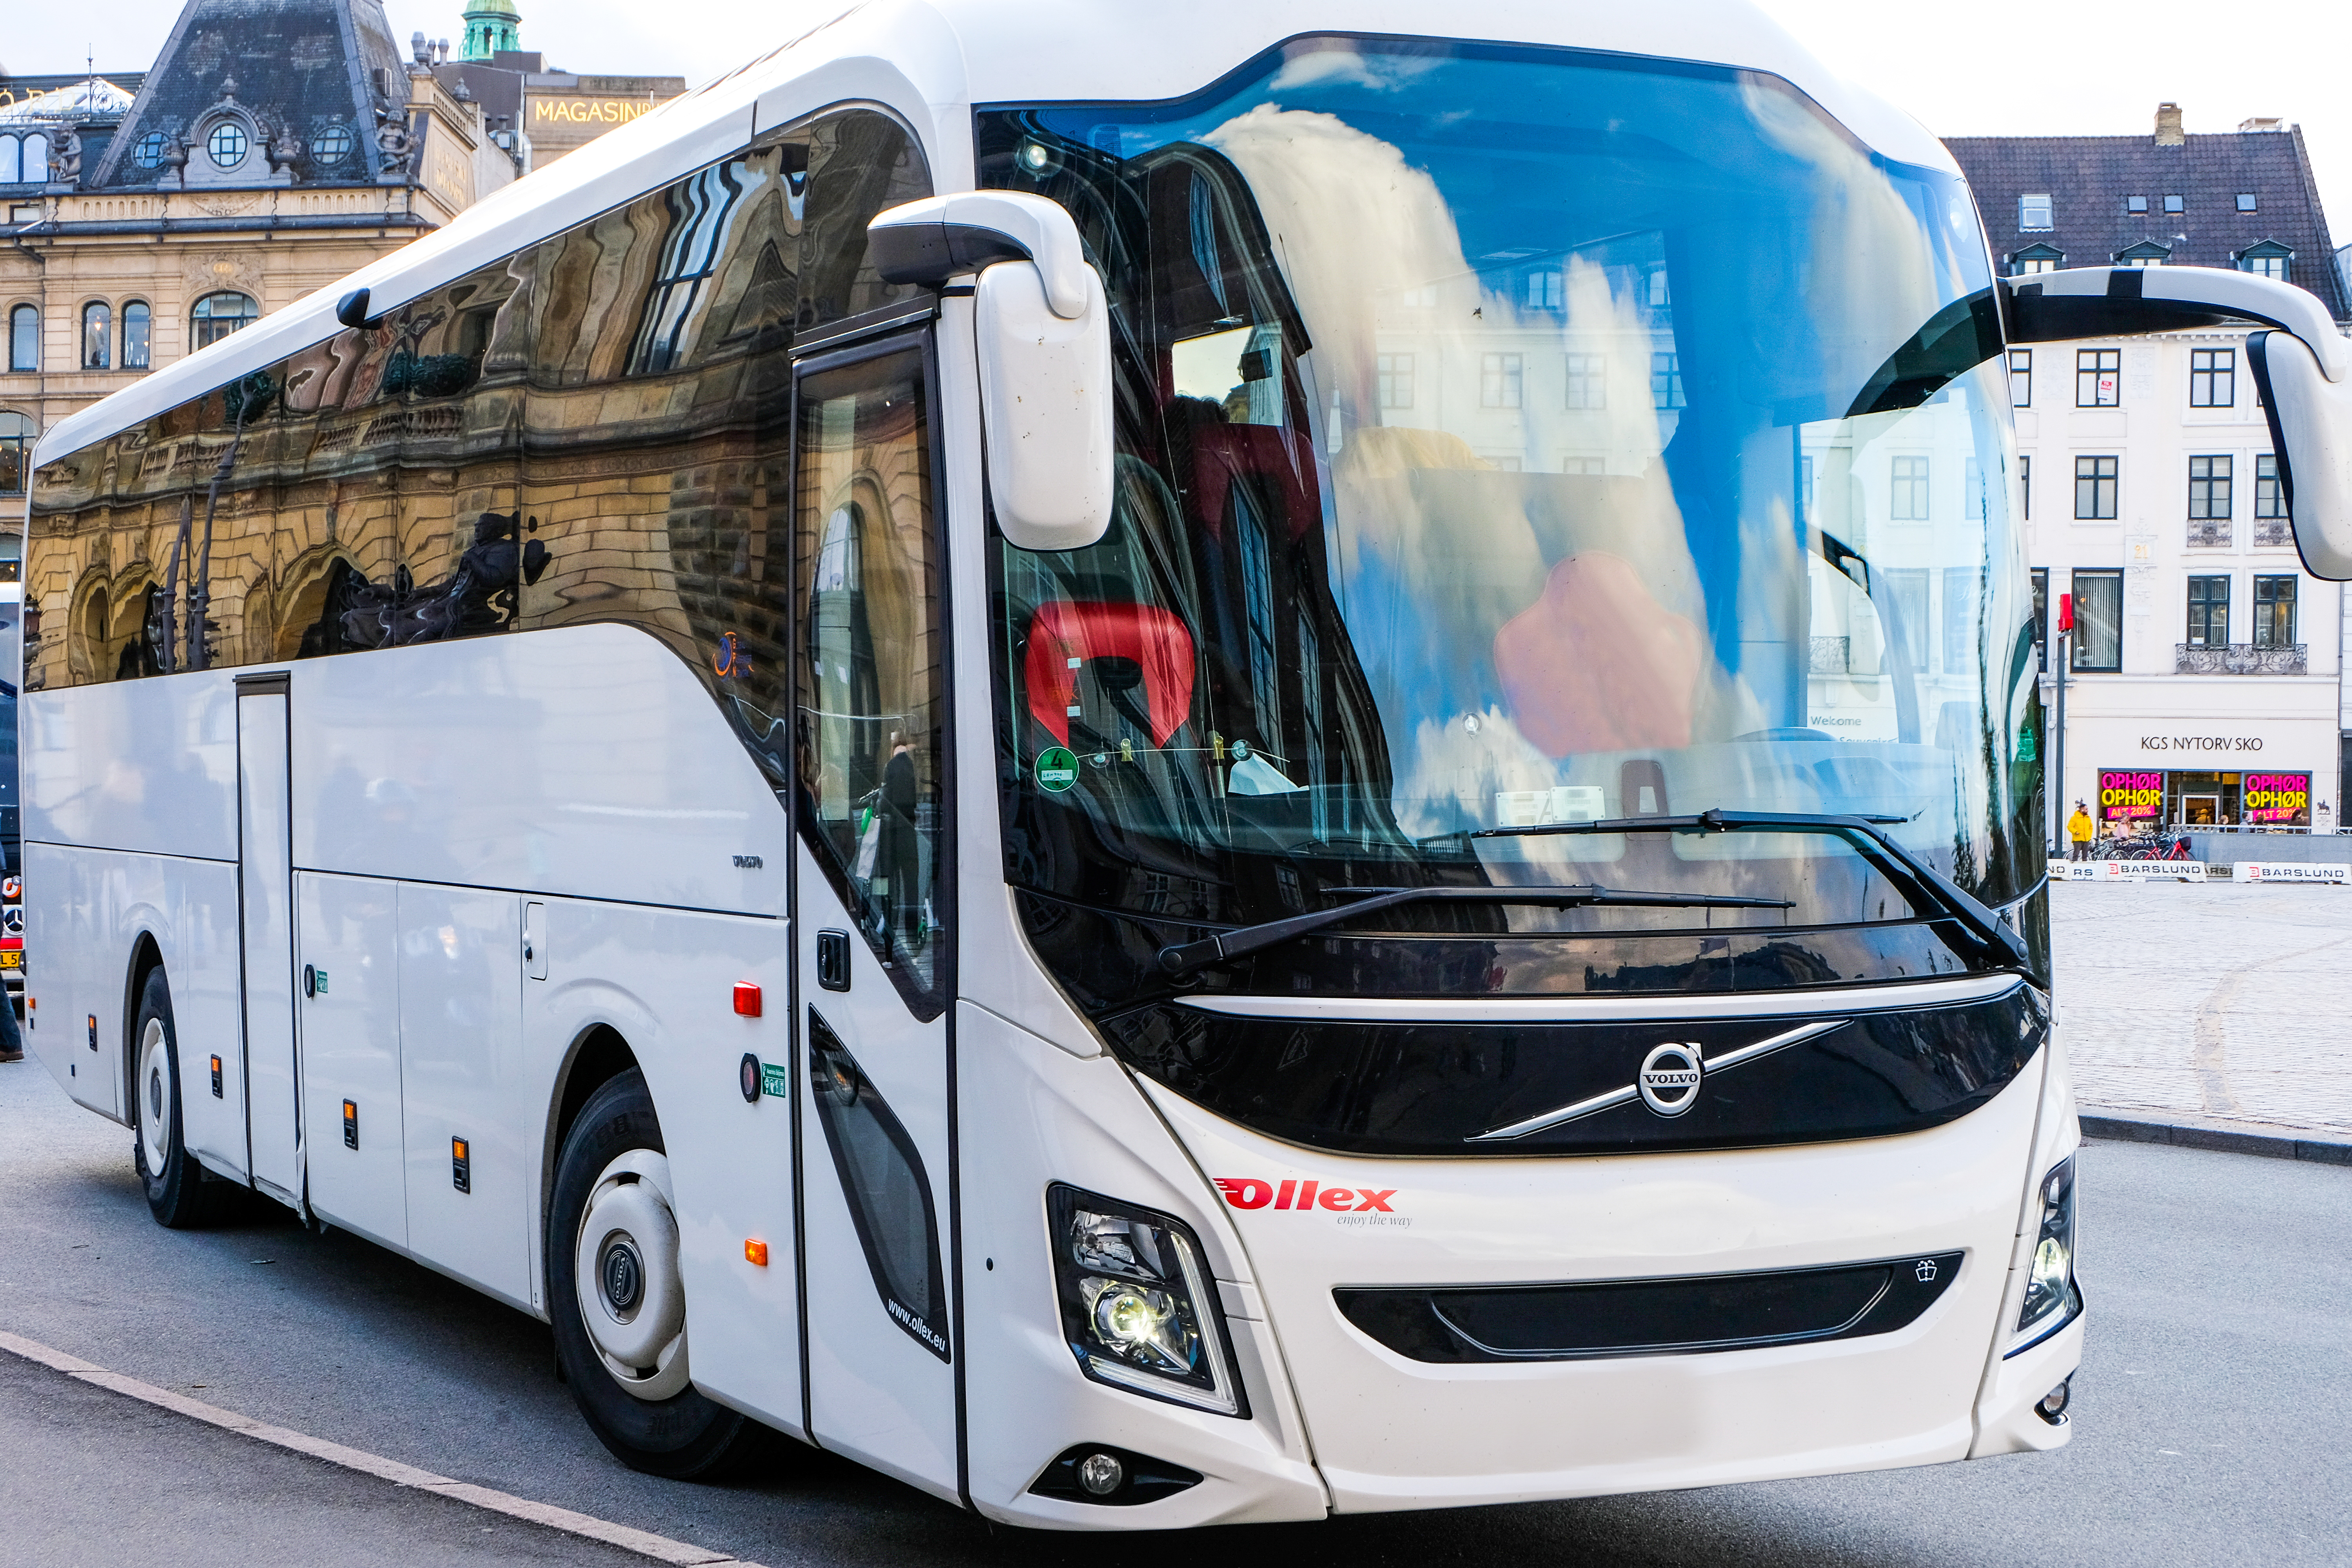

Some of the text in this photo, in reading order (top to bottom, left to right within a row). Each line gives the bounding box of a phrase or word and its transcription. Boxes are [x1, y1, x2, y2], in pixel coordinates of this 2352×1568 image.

[535, 101, 641, 122] MAGASIN
[2134, 545, 2148, 558] 21
[1811, 716, 1862, 725] Welcome
[2141, 737, 2263, 750] KGS NYTORV SKO
[1051, 750, 1063, 769] 4
[2102, 773, 2161, 789] OPHØR
[2247, 775, 2307, 791] OPHØR
[2102, 789, 2161, 806] OPHØR
[2247, 791, 2307, 808] OPHØR
[2131, 806, 2151, 815] 20%
[2121, 865, 2200, 873] BARSLUND
[2262, 869, 2336, 877] BARSLUND
[1642, 1074, 1699, 1083] VOLVO
[1212, 1178, 1398, 1212] Ollex
[1338, 1214, 1412, 1229] enjoy the way
[615, 1257, 626, 1299] VOLVO
[889, 1298, 946, 1352] www.ollex.eu
